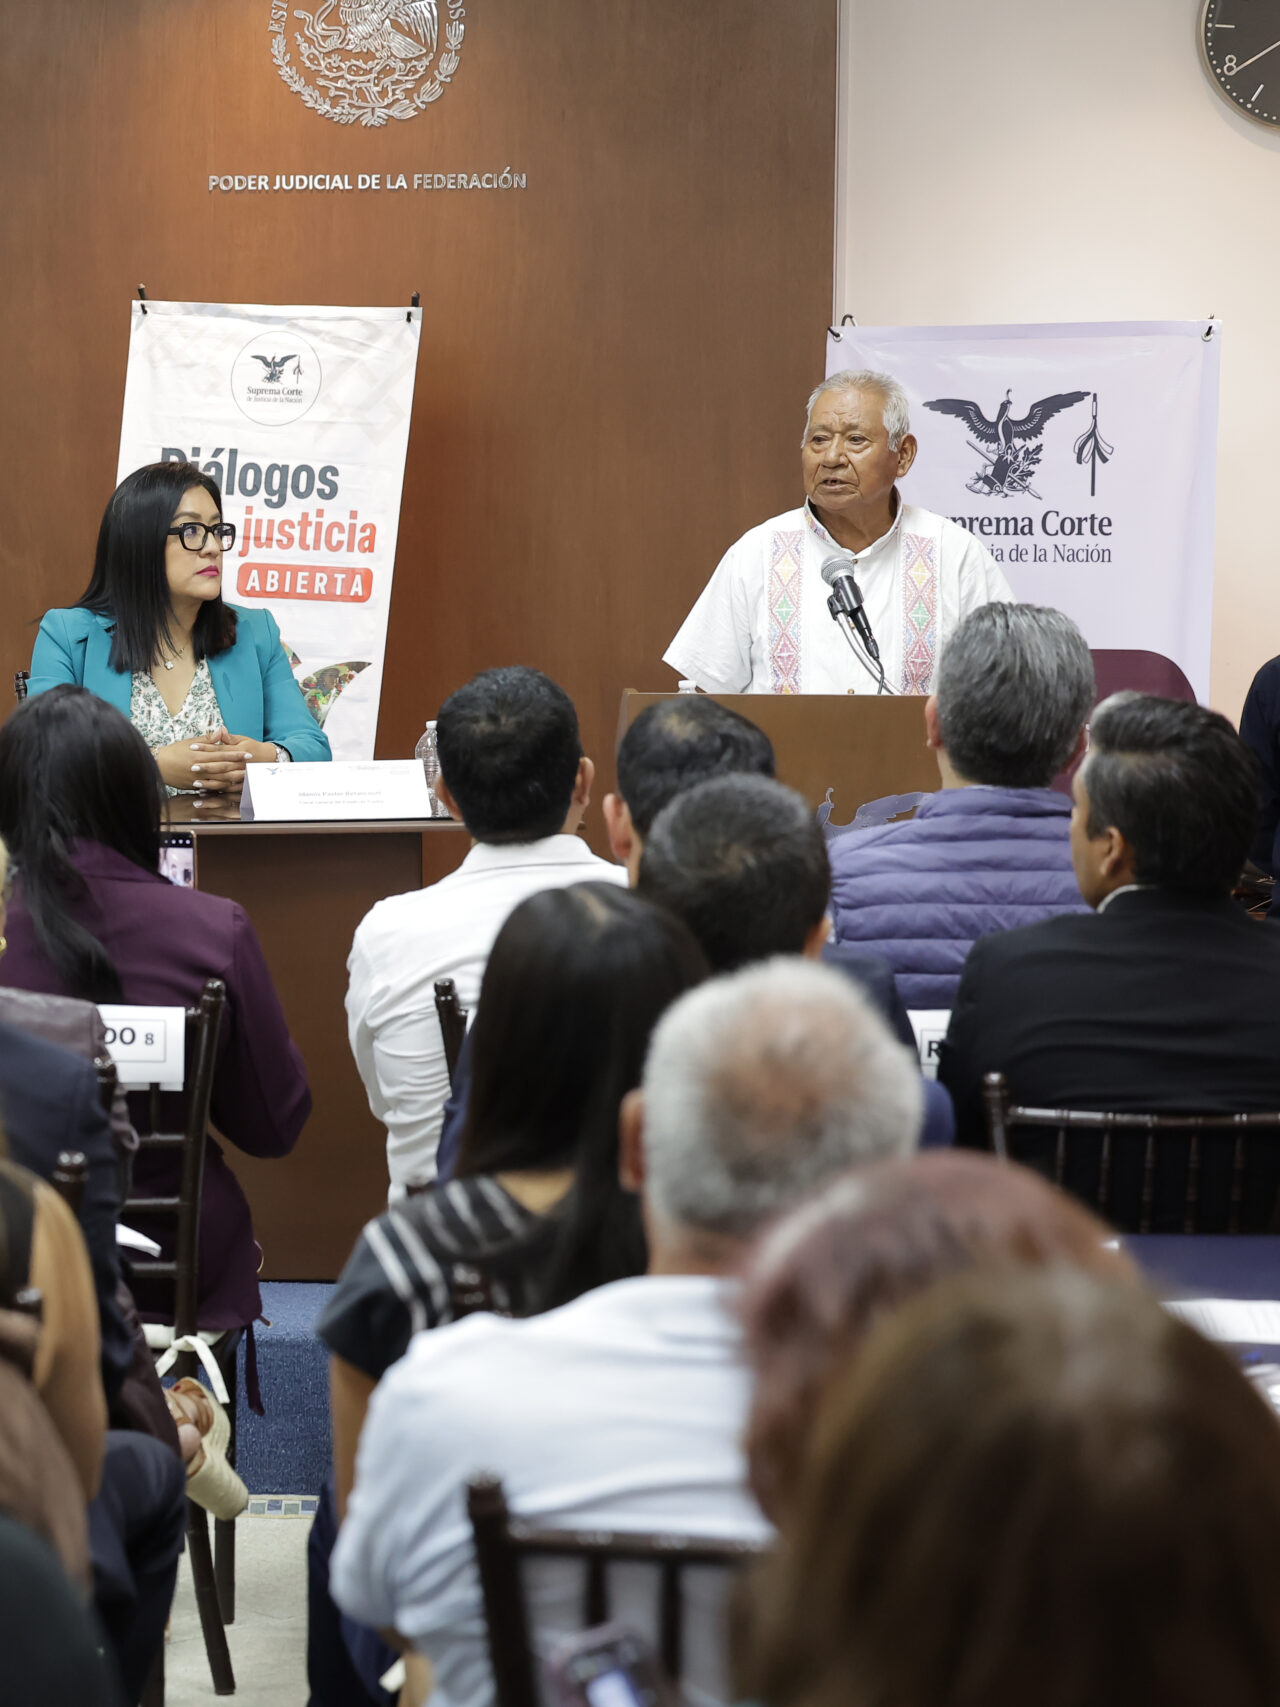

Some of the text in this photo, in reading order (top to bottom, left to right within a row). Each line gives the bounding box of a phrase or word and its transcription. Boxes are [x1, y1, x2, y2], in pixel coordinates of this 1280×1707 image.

[1223, 54, 1237, 76] 8
[208, 166, 527, 191] PODER JUDICIAL DE LA FEDERACIÓN
[247, 386, 303, 396] Suprema Corte
[238, 505, 377, 557] justicia
[1041, 510, 1113, 536] Corte
[1009, 544, 1029, 563] de
[1033, 544, 1048, 563] la
[1053, 543, 1113, 563] Nación
[246, 568, 364, 598] ABIERTA
